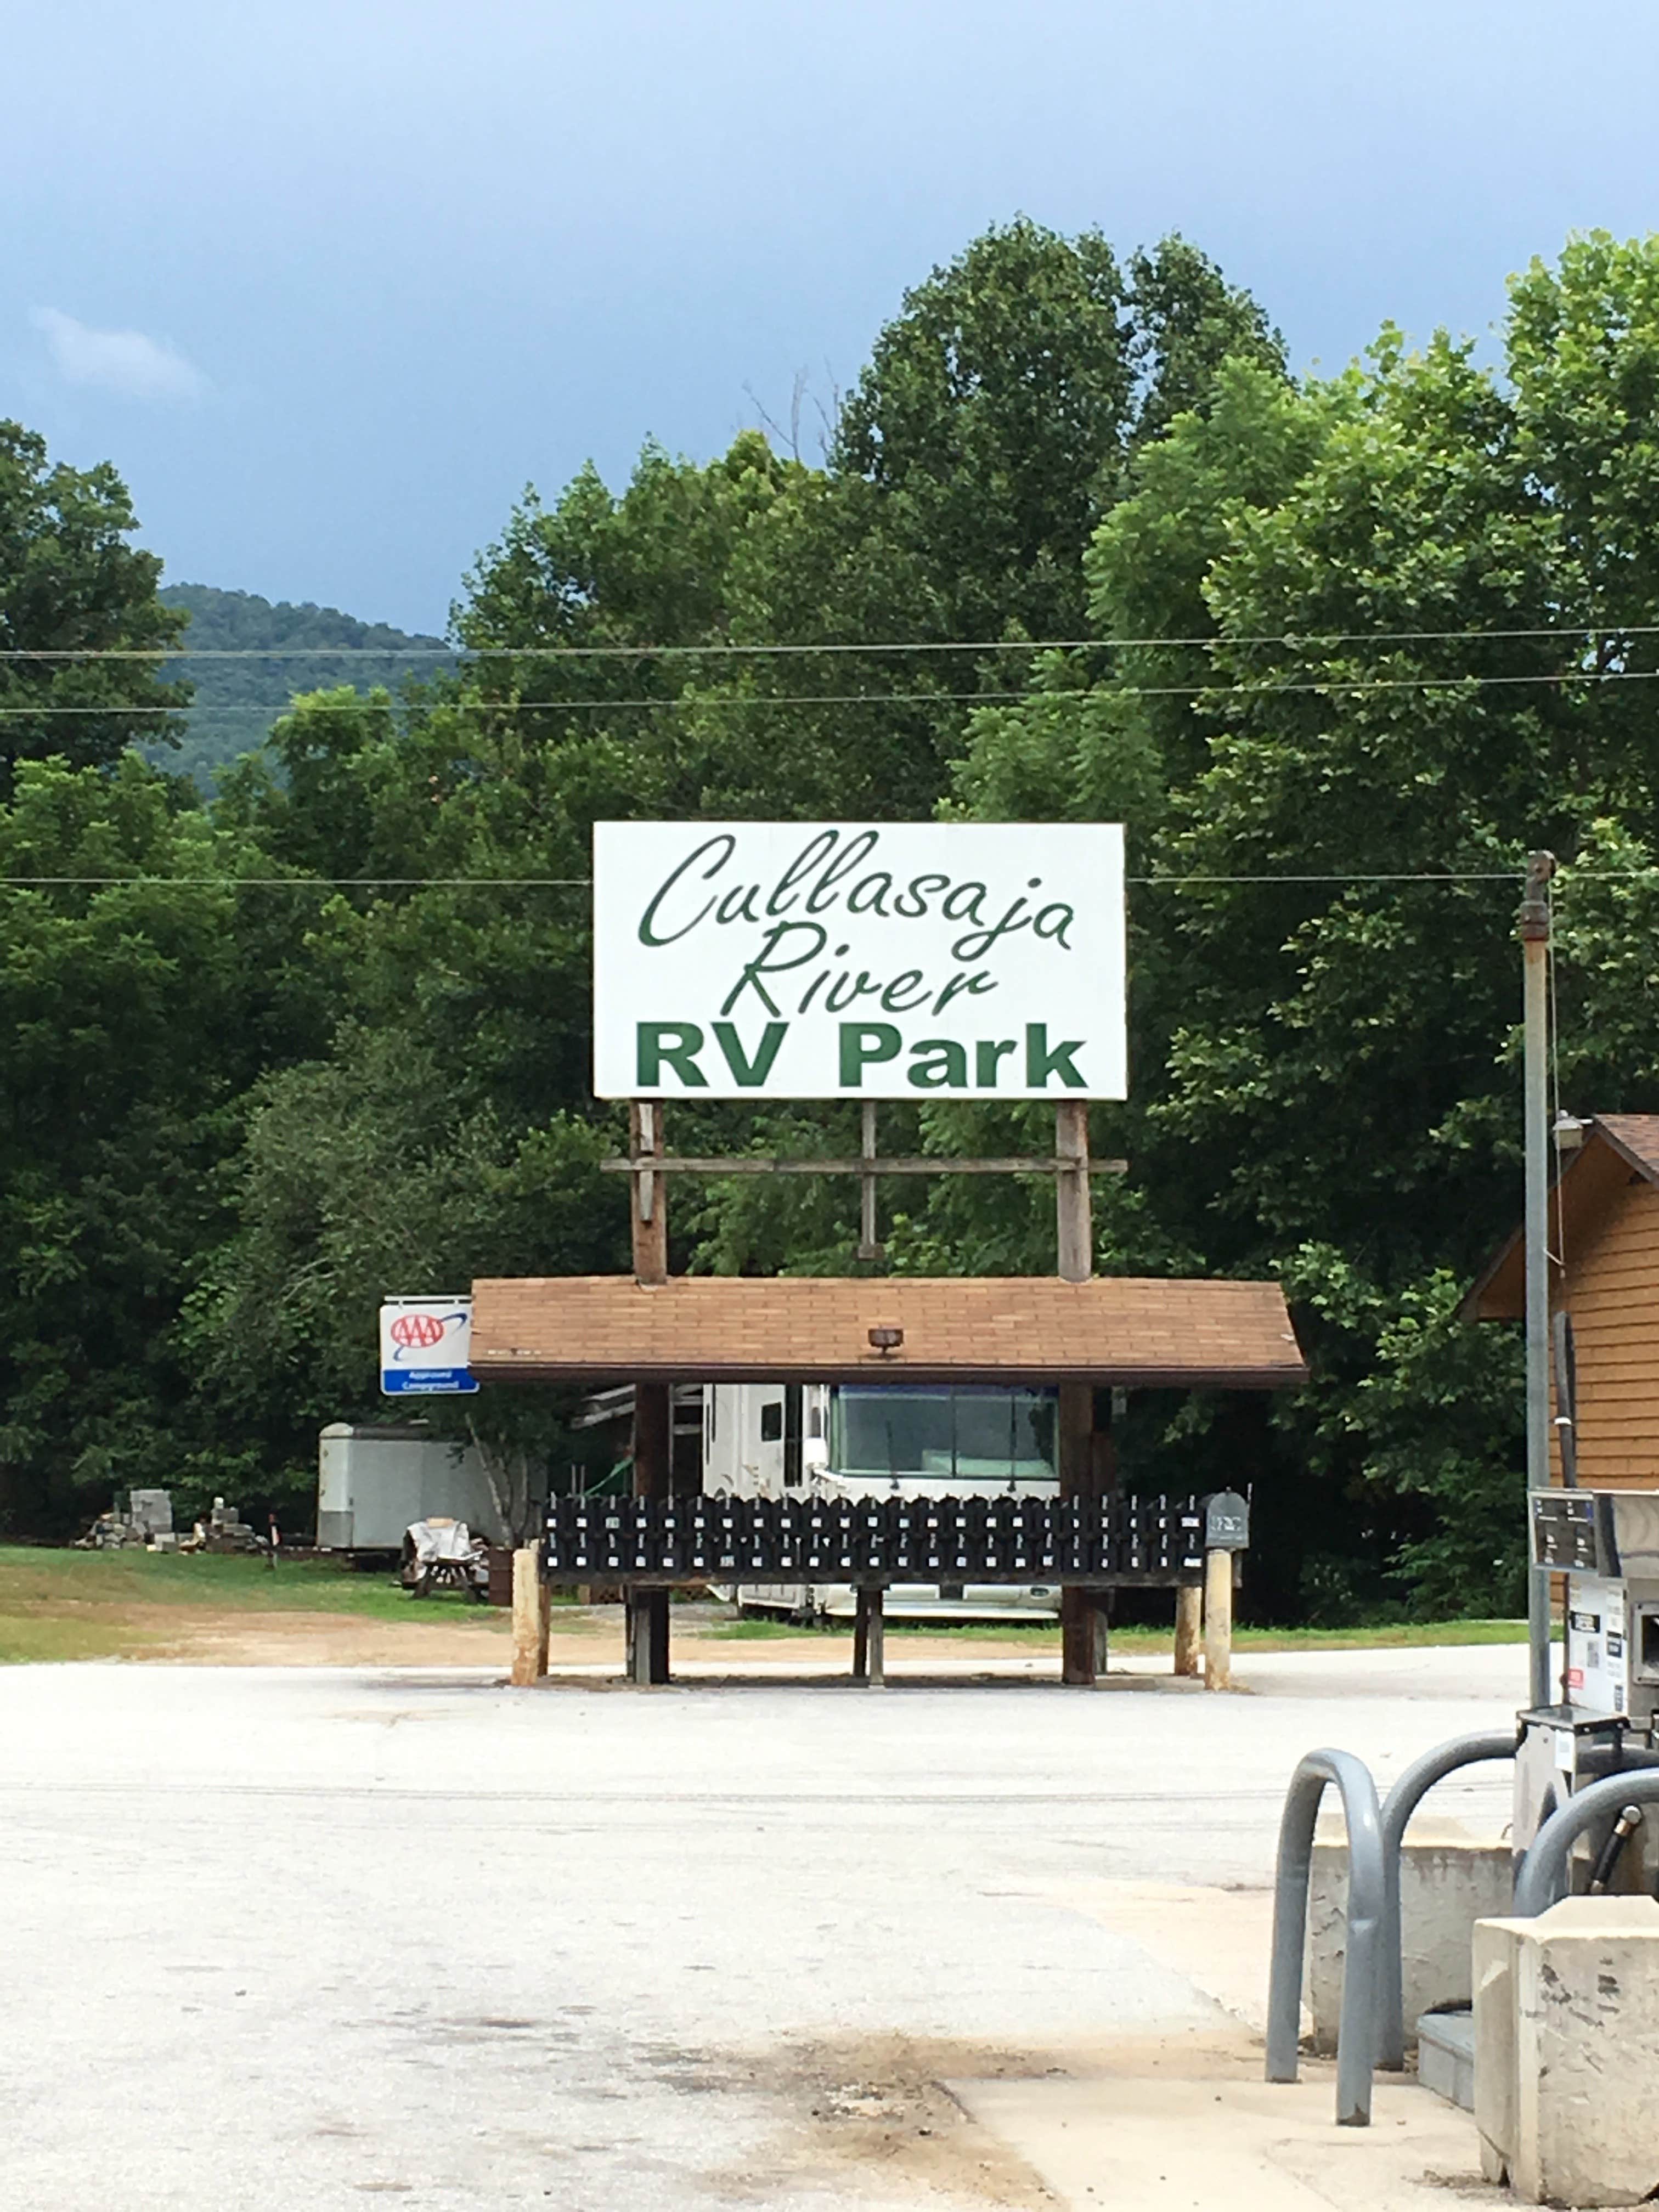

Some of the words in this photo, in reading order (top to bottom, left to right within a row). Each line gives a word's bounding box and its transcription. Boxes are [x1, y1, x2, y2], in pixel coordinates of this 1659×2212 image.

[638, 830, 1074, 962] Cullasaja
[720, 921, 998, 1018] River
[636, 1022, 790, 1087] RV
[839, 1022, 1088, 1089] Park
[394, 1315, 441, 1346] AAA
